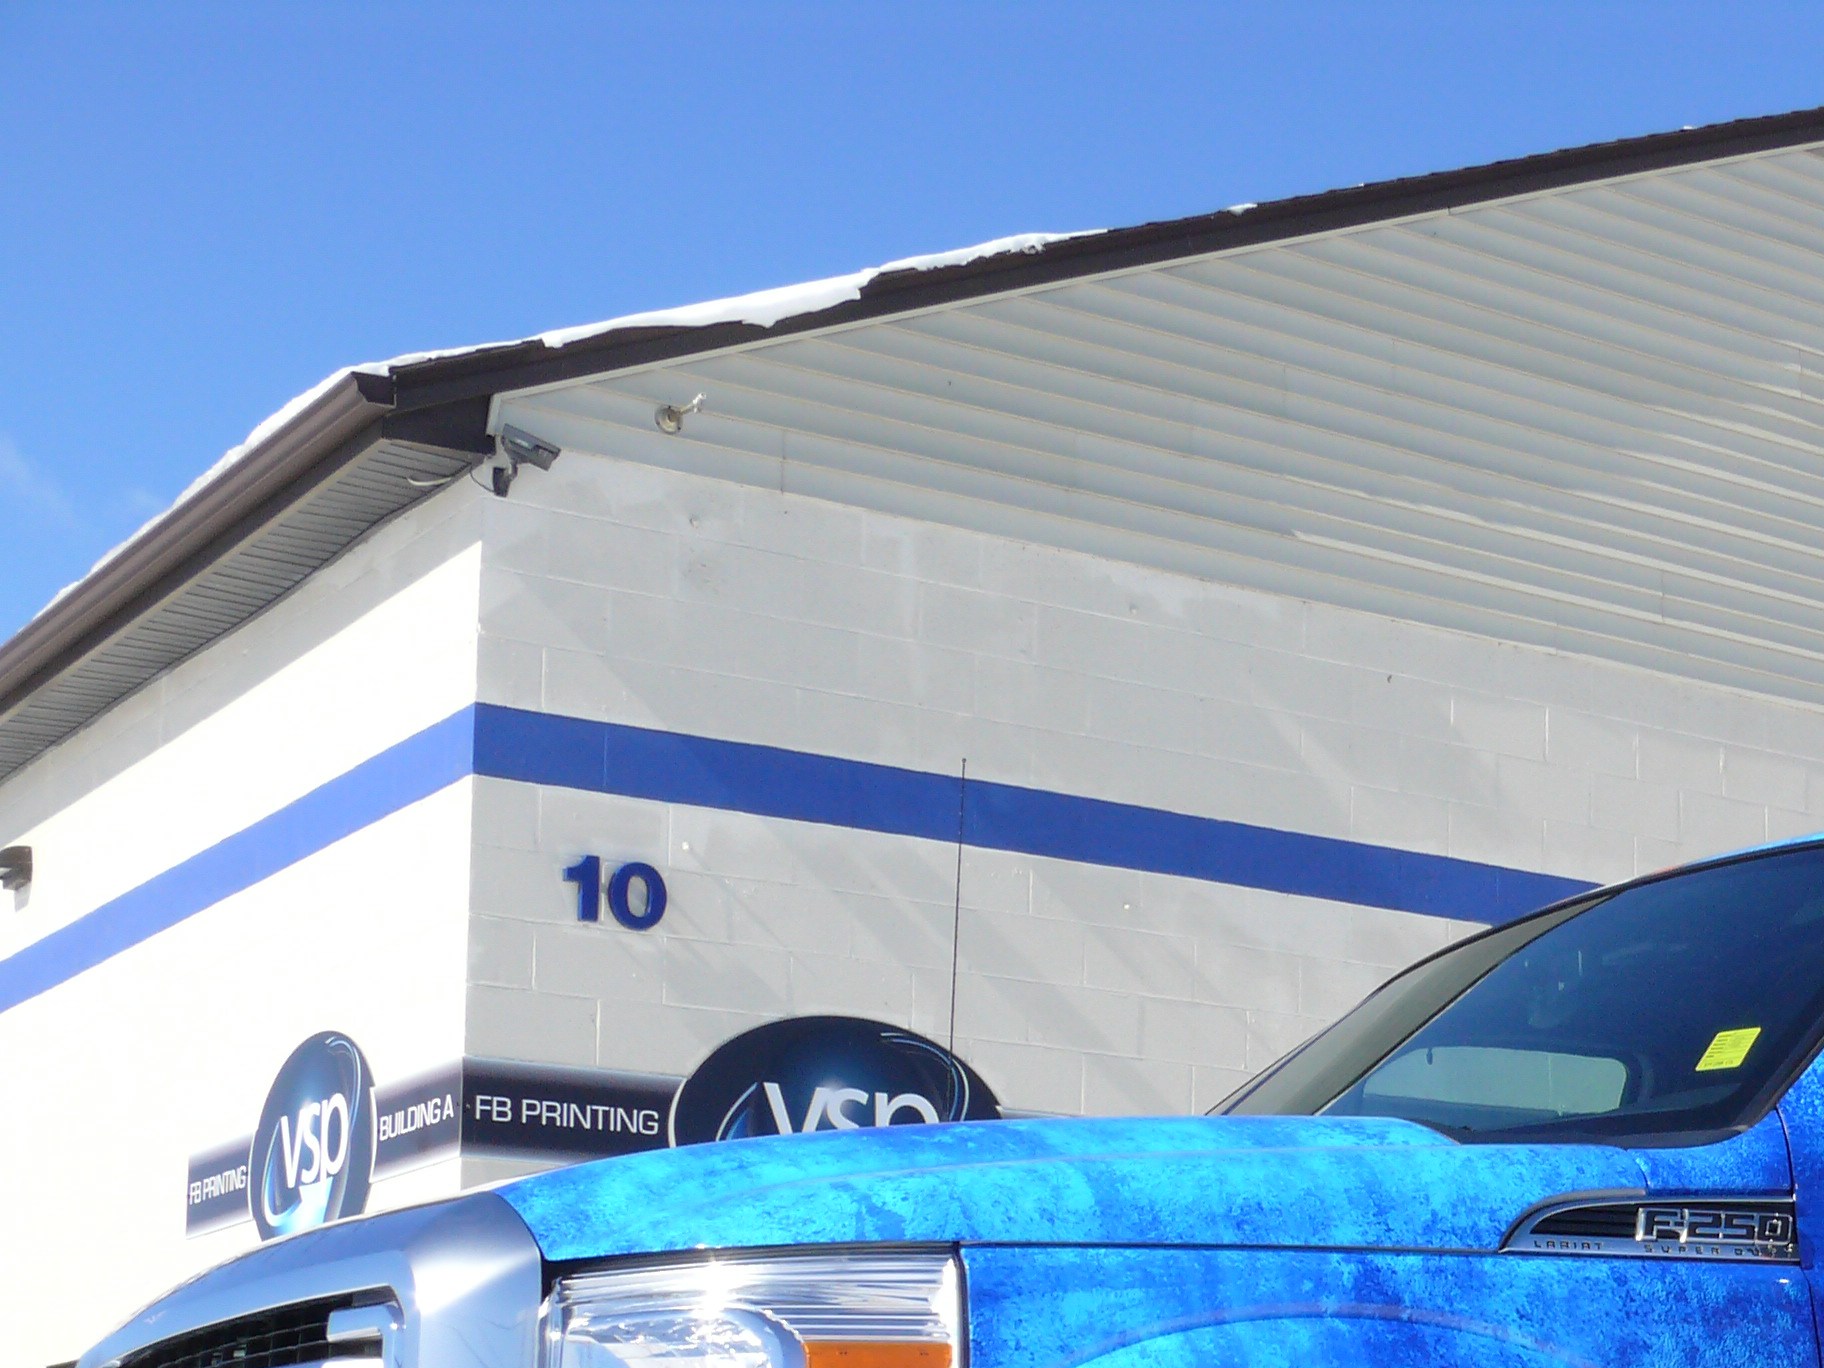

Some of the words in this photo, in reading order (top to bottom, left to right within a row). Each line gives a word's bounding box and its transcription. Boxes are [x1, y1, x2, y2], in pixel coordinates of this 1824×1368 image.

[562, 855, 667, 930] 10
[379, 1097, 442, 1142] BUILDING
[442, 1094, 455, 1120] A
[474, 1094, 513, 1123] FB
[520, 1098, 660, 1136] PRINTING
[189, 1181, 201, 1205] FB
[202, 1165, 247, 1201] PRINTING
[1533, 1239, 1602, 1251] LARIAT
[1644, 1243, 1721, 1256] SUPER
